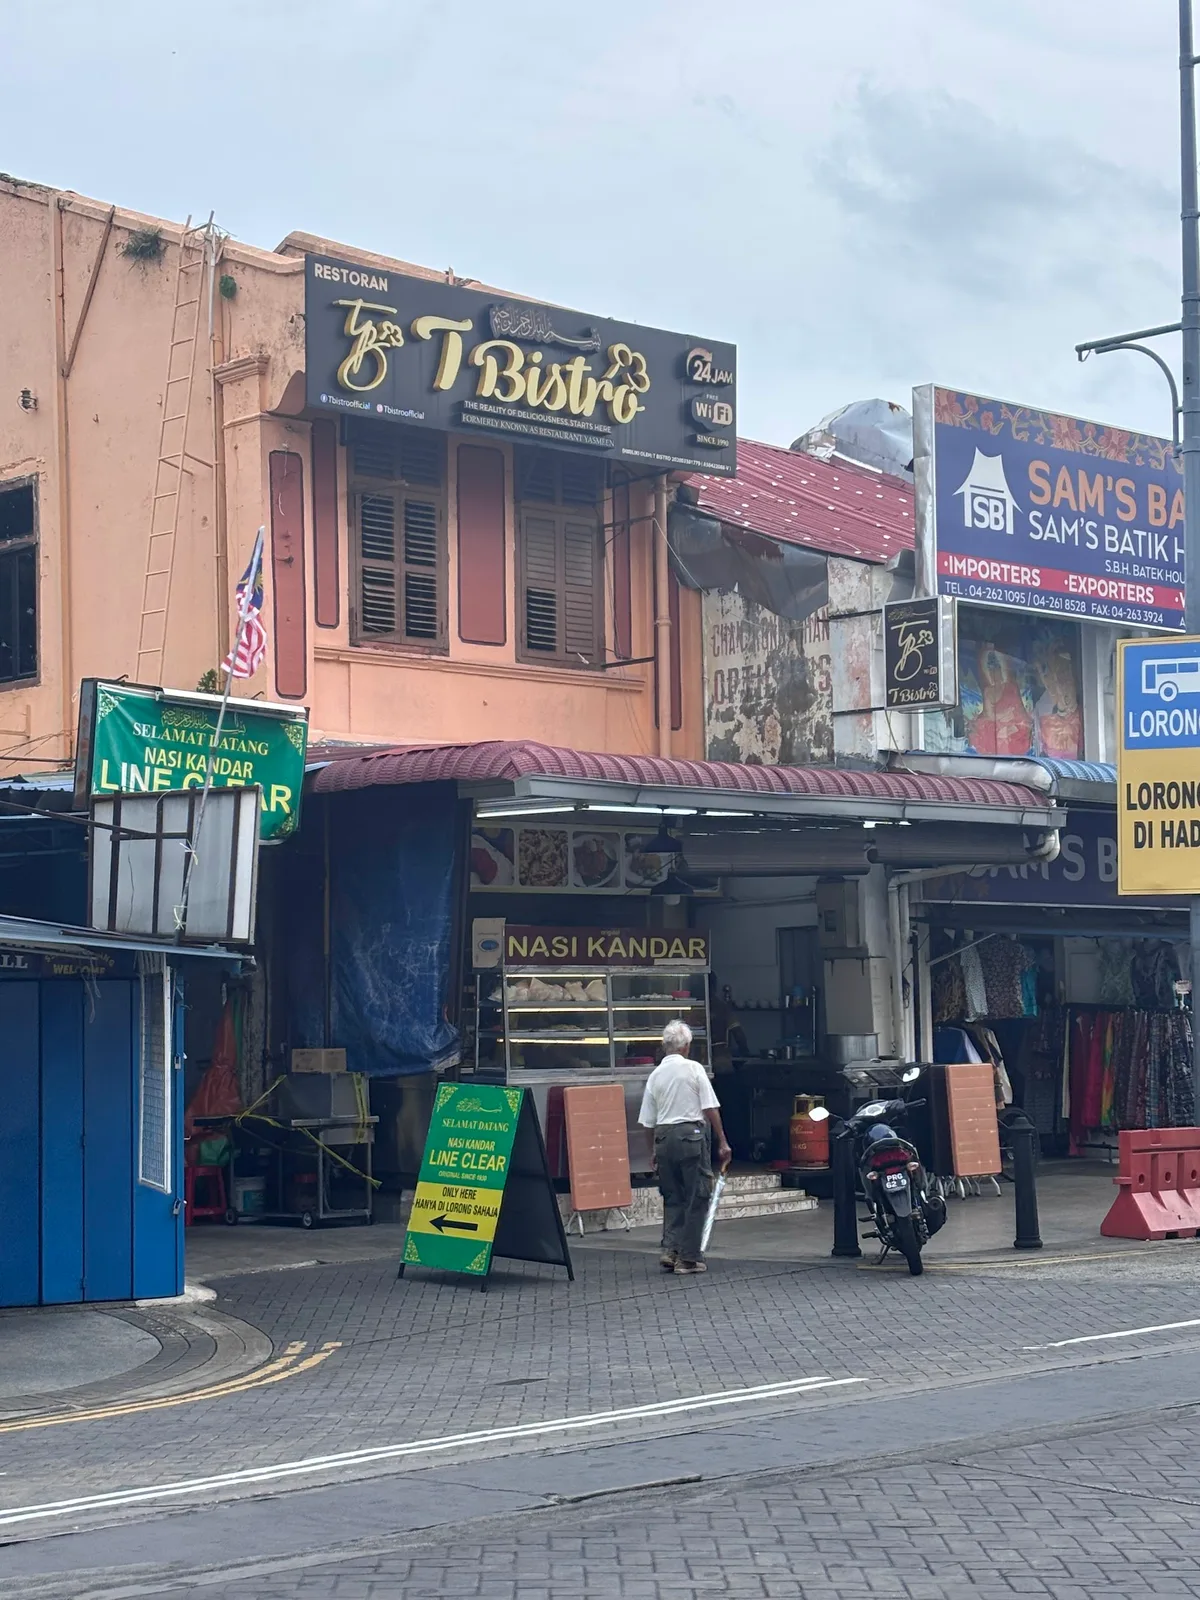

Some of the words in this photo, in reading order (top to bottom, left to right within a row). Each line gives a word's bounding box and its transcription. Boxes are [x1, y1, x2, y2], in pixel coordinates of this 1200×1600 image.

[314, 263, 388, 292] RESTORAN
[411, 315, 473, 392] T
[469, 339, 646, 425] Bistro
[693, 360, 711, 383] 24
[711, 368, 733, 384] JAM
[462, 413, 499, 429] FORMERLY
[500, 419, 528, 433] KNOWN
[529, 425, 539, 435] AS
[539, 427, 583, 443] RESTAURANT
[583, 435, 615, 448] YASMEEN
[464, 400, 478, 411] THE
[479, 404, 507, 416] REALITY
[507, 409, 517, 417] OF
[595, 424, 612, 434] HERE
[697, 434, 717, 445] SINCE
[1028, 460, 1137, 523] SAM'S
[1029, 511, 1099, 550] SAM'S
[1105, 525, 1169, 563] BATIK
[949, 555, 1041, 587] IMPORTERS
[1105, 560, 1132, 576] S.B.H.
[1132, 564, 1164, 581] BATEK
[969, 585, 1003, 600] 04-262
[1004, 589, 1026, 604] 1095
[1033, 594, 1063, 609] 04-261
[1064, 599, 1086, 613] 8528
[1068, 574, 1155, 604] EXPORTERS
[1091, 602, 1111, 616] FAX:
[1111, 606, 1141, 621] 04-263
[1143, 610, 1164, 624] 3924
[888, 687, 900, 703] T
[900, 687, 937, 702] Bistro
[133, 722, 206, 747] SELAMAT
[1128, 708, 1200, 738] LORON
[101, 759, 173, 793] LINE
[144, 746, 182, 769] NASI
[186, 754, 254, 779] KANDAR
[1126, 780, 1200, 811] LORON
[1134, 821, 1153, 849] DI
[1161, 819, 1200, 849] HAD
[507, 935, 577, 958] NASI
[587, 936, 706, 959] KANDAR
[442, 1117, 478, 1130] SELAMAT
[478, 1121, 510, 1133] DATANG
[448, 1137, 465, 1149] NASI
[465, 1139, 496, 1152] KANDAR
[429, 1149, 460, 1167] LINE
[461, 1152, 506, 1172] CLEAR
[438, 1170, 460, 1179] ORIGINAL
[461, 1172, 476, 1181] SINCE
[442, 1186, 460, 1198] ONLY
[460, 1188, 478, 1200] HERE
[415, 1198, 437, 1211] HANYA
[437, 1200, 445, 1211] DI
[445, 1201, 473, 1215] LORONG
[473, 1204, 498, 1218] SAHAJA
